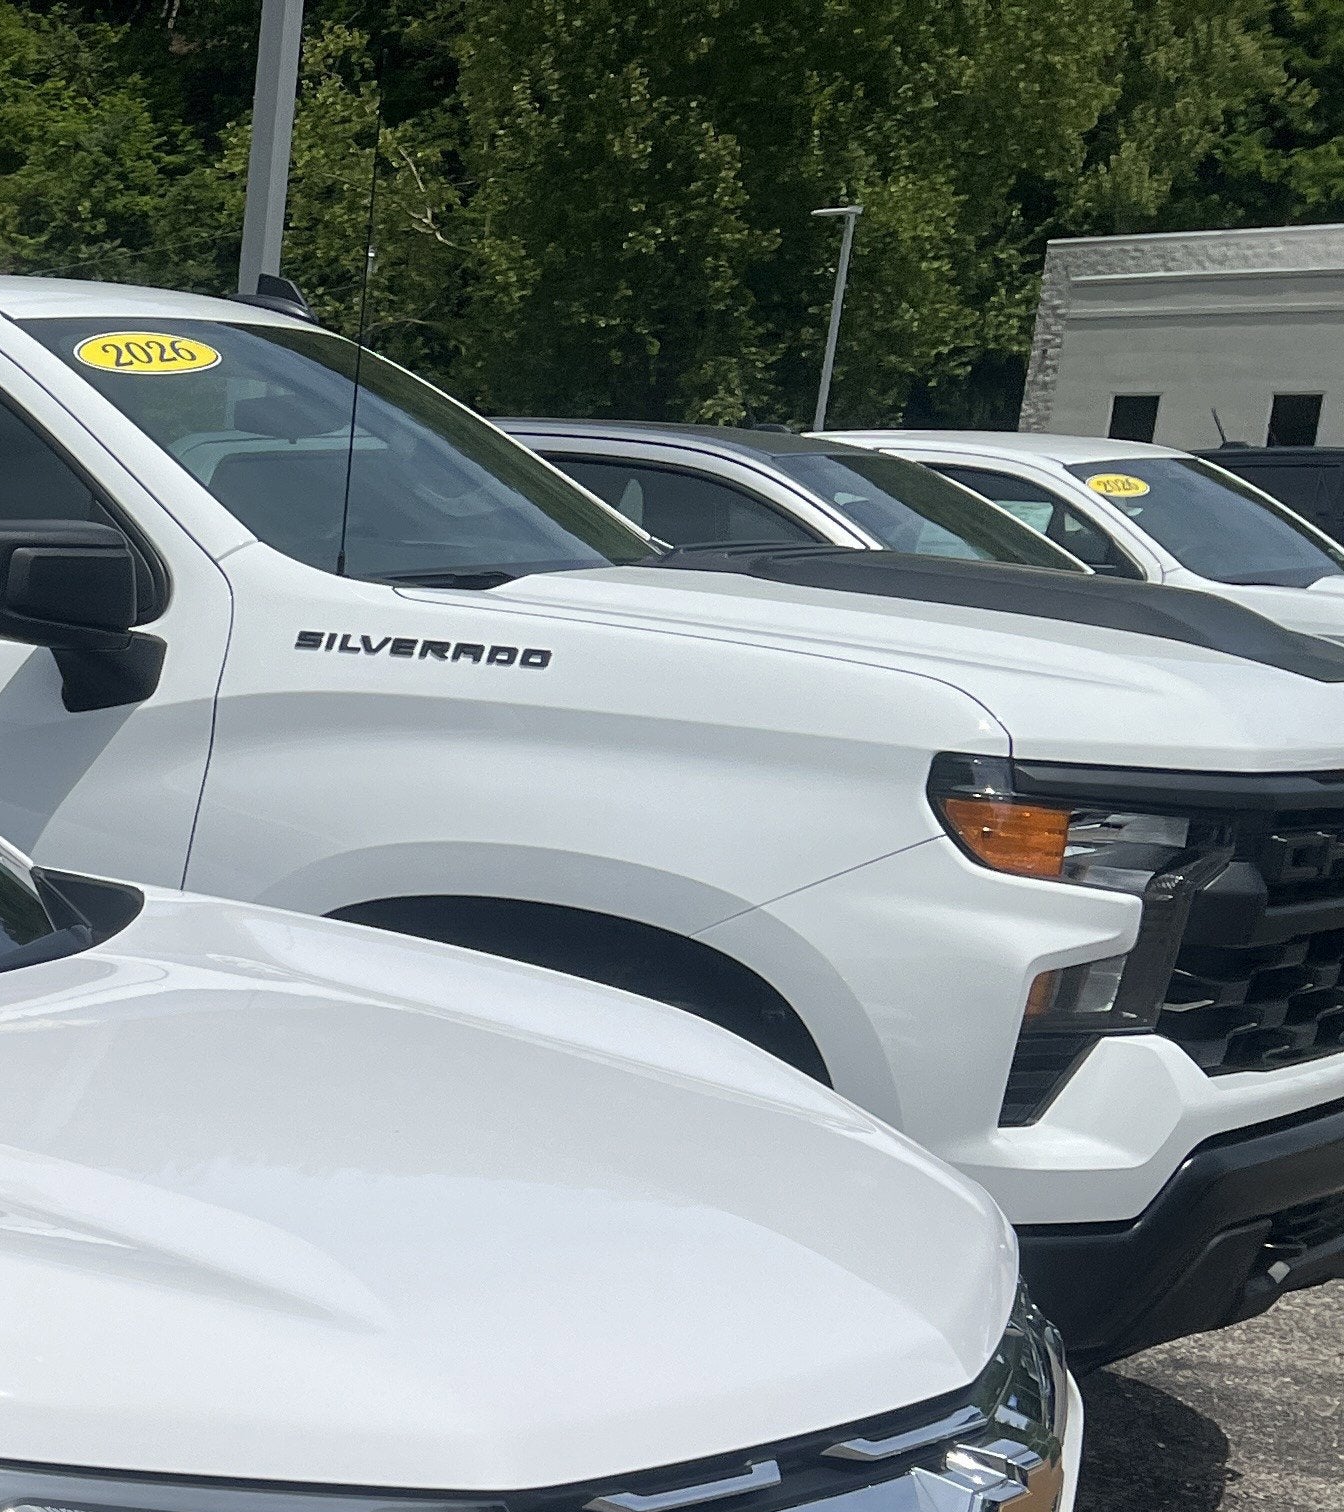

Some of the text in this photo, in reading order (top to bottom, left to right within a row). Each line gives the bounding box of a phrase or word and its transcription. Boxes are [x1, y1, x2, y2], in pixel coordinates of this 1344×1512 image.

[101, 339, 198, 367] 2026
[1096, 478, 1140, 493] 2026
[294, 629, 553, 671] SILVERADO
